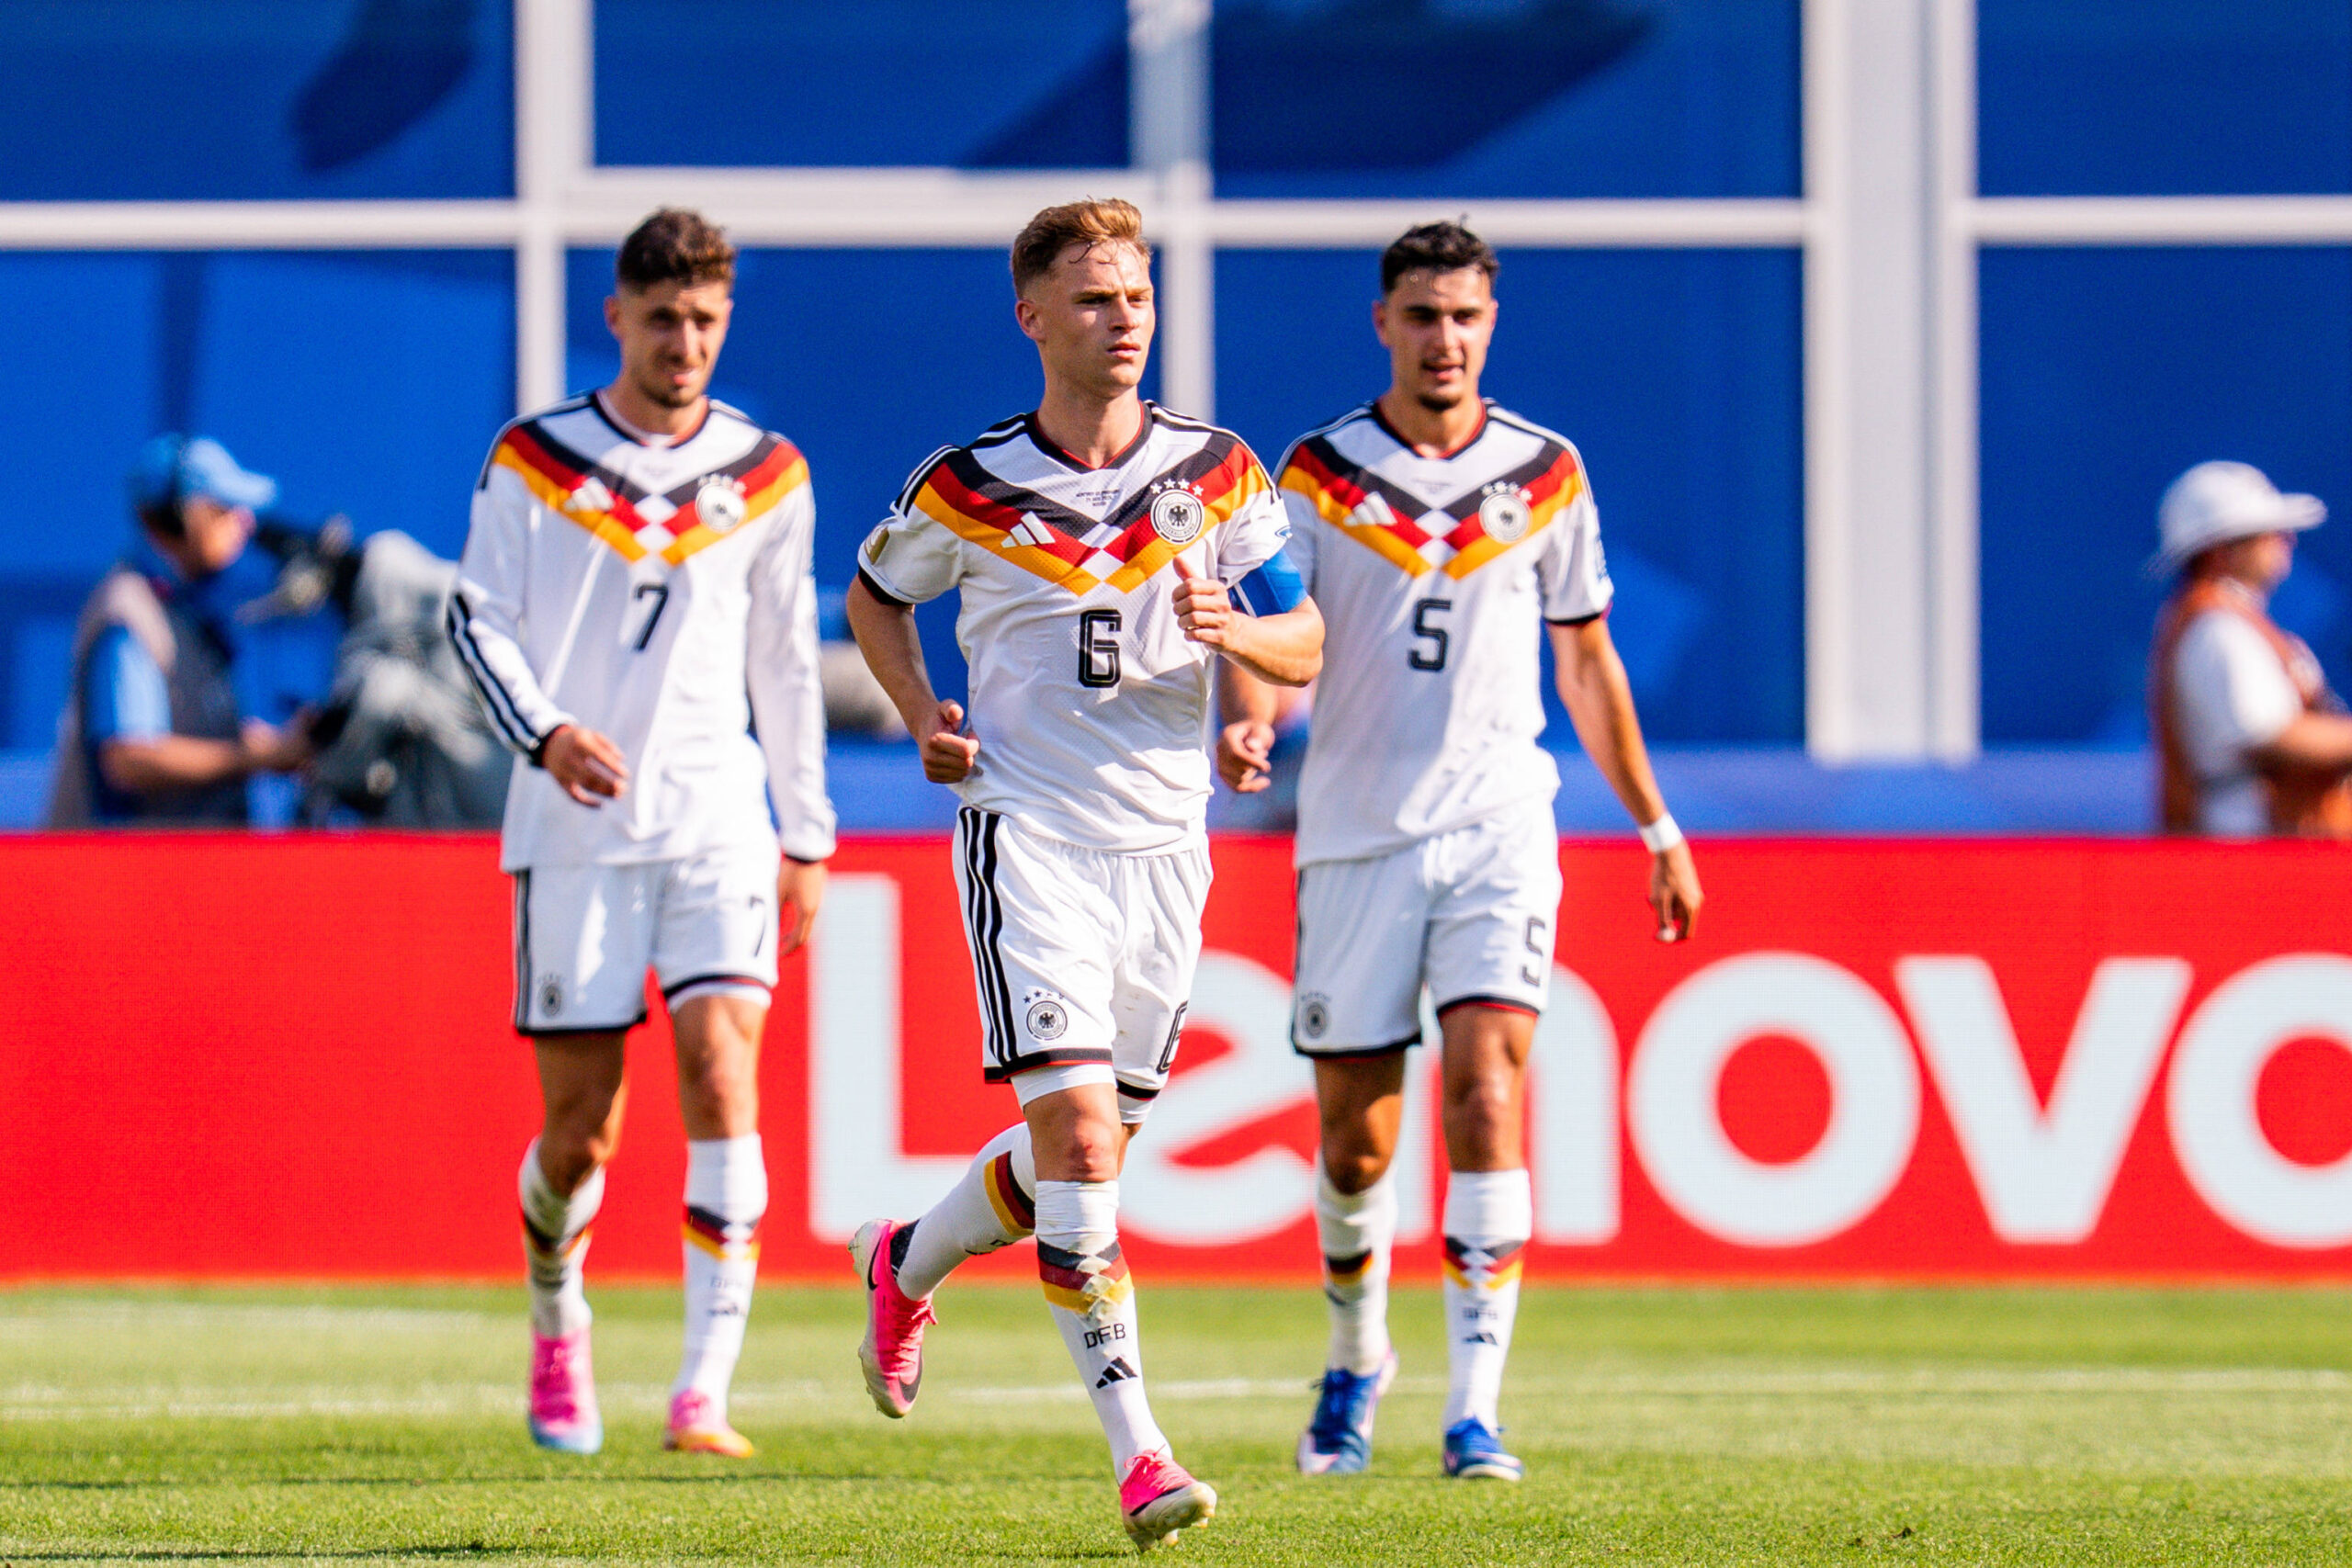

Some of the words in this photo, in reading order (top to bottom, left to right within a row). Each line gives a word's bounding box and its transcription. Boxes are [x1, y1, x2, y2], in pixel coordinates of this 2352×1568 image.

[634, 583, 670, 652] 7
[1078, 608, 1122, 689] 6
[1408, 598, 1453, 672] 5
[749, 895, 766, 959] 7
[1521, 915, 1546, 987] 5
[808, 874, 2352, 1247] Lenovo
[1083, 1323, 1126, 1349] DFB
